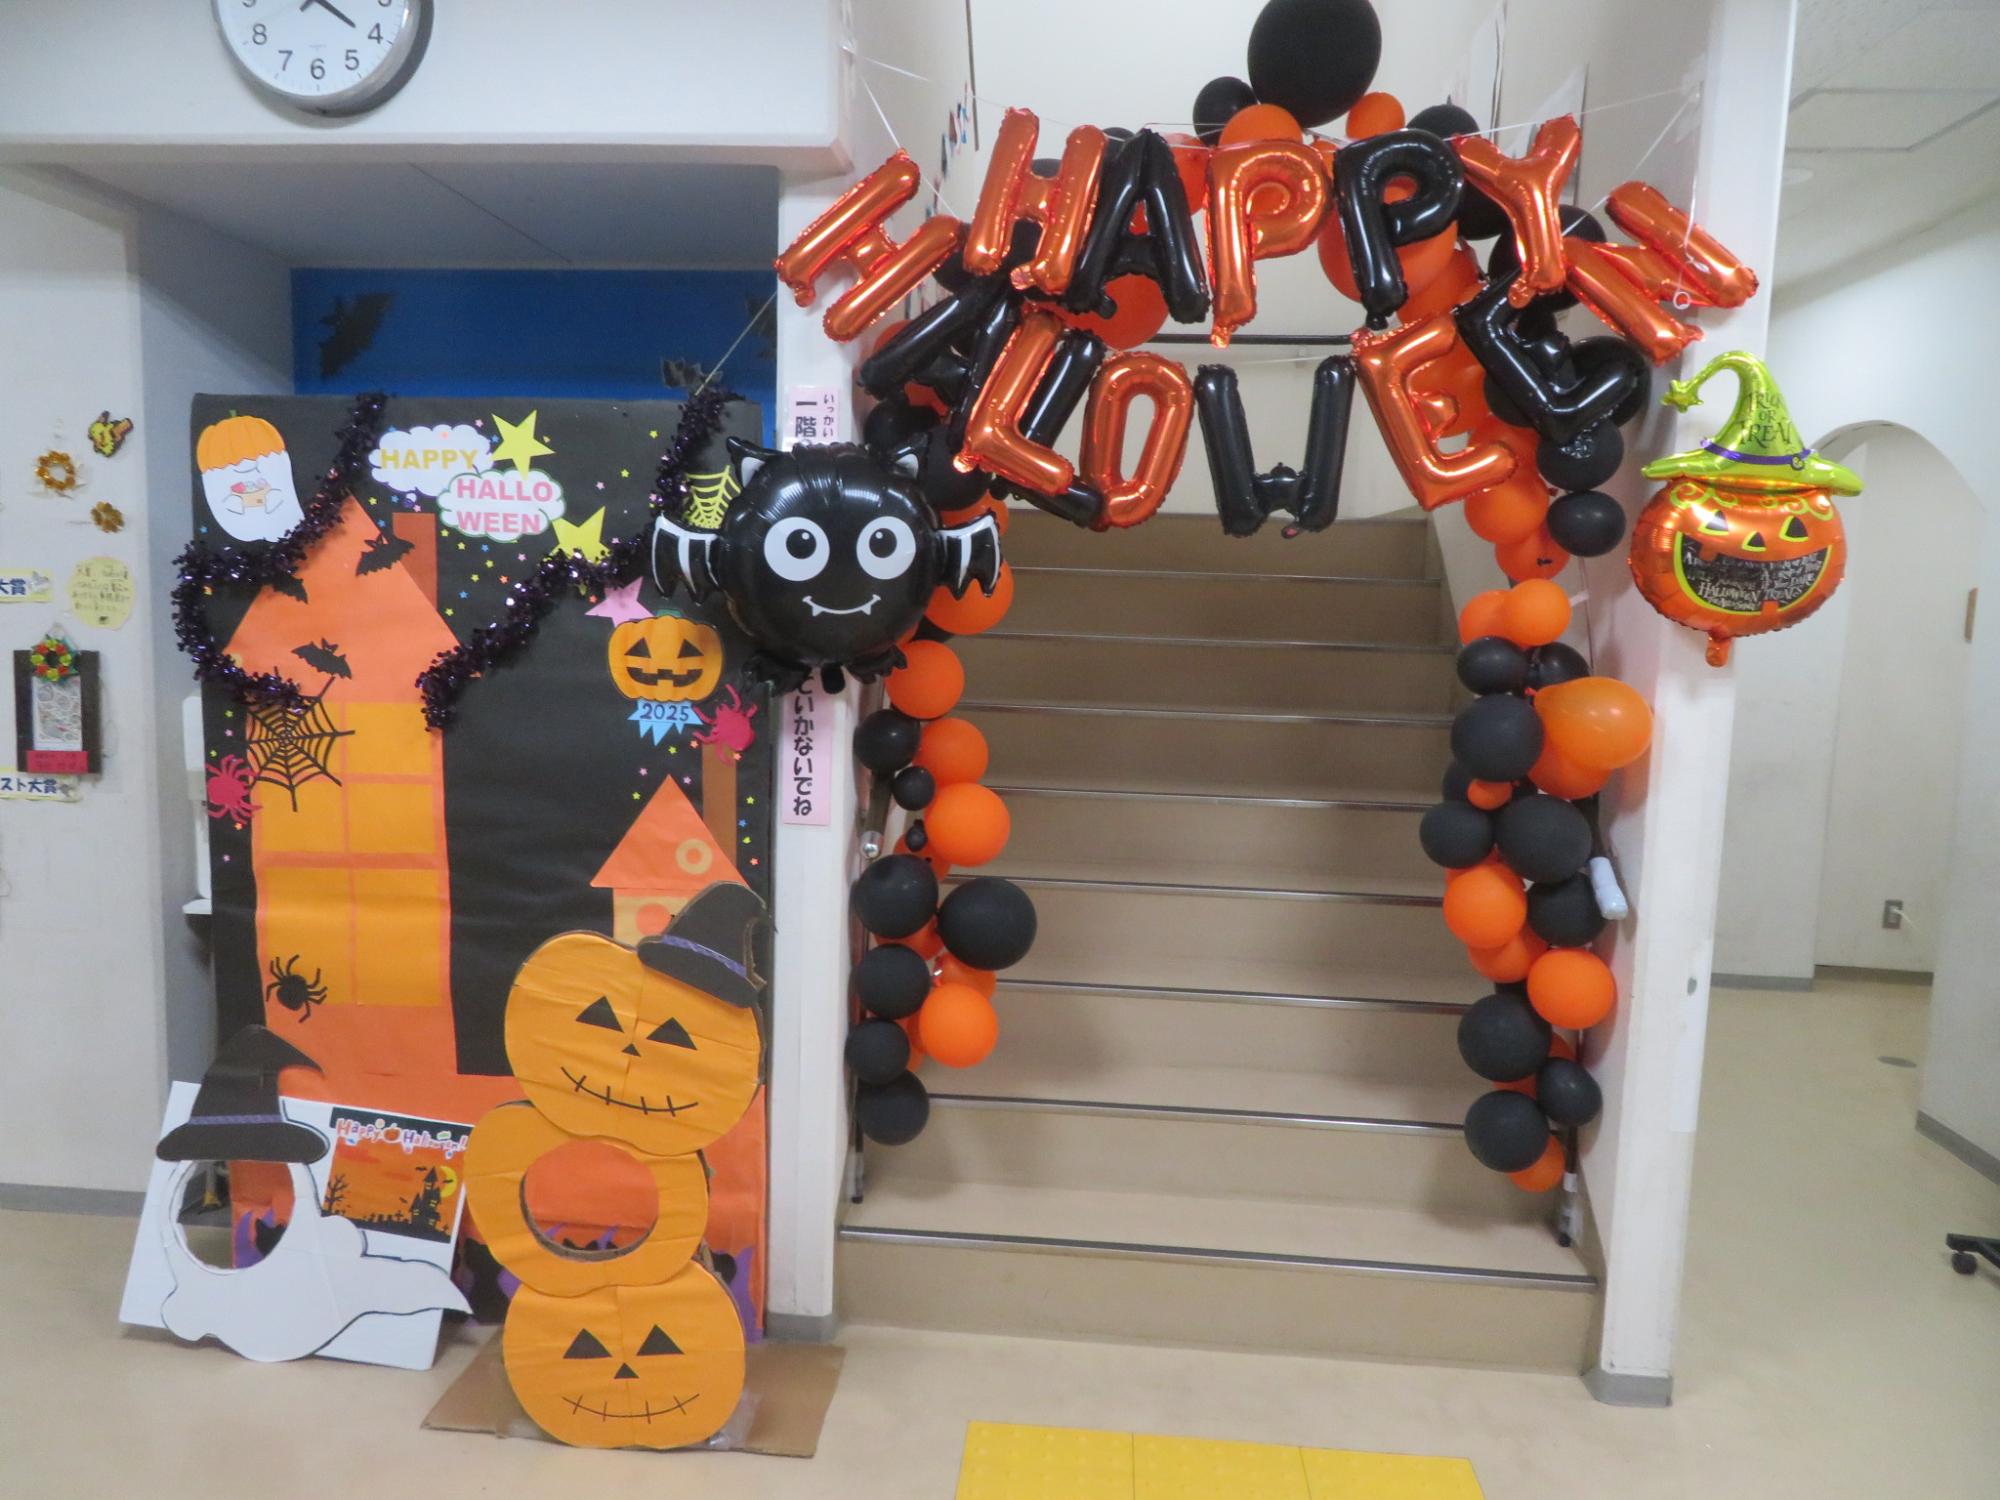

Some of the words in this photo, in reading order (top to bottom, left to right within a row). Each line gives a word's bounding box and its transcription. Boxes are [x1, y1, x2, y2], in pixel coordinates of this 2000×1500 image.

[252, 23, 268, 45] 8
[368, 22, 384, 44] 4
[278, 50, 293, 71] 7
[310, 58, 326, 80] 6
[344, 49, 360, 71] 5
[962, 106, 1581, 348] HAPPY
[379, 448, 479, 470] HAPPY
[456, 478, 554, 503] HALLO
[456, 510, 542, 534] WEEN
[639, 702, 690, 722] 2025
[335, 1118, 383, 1143] Happy
